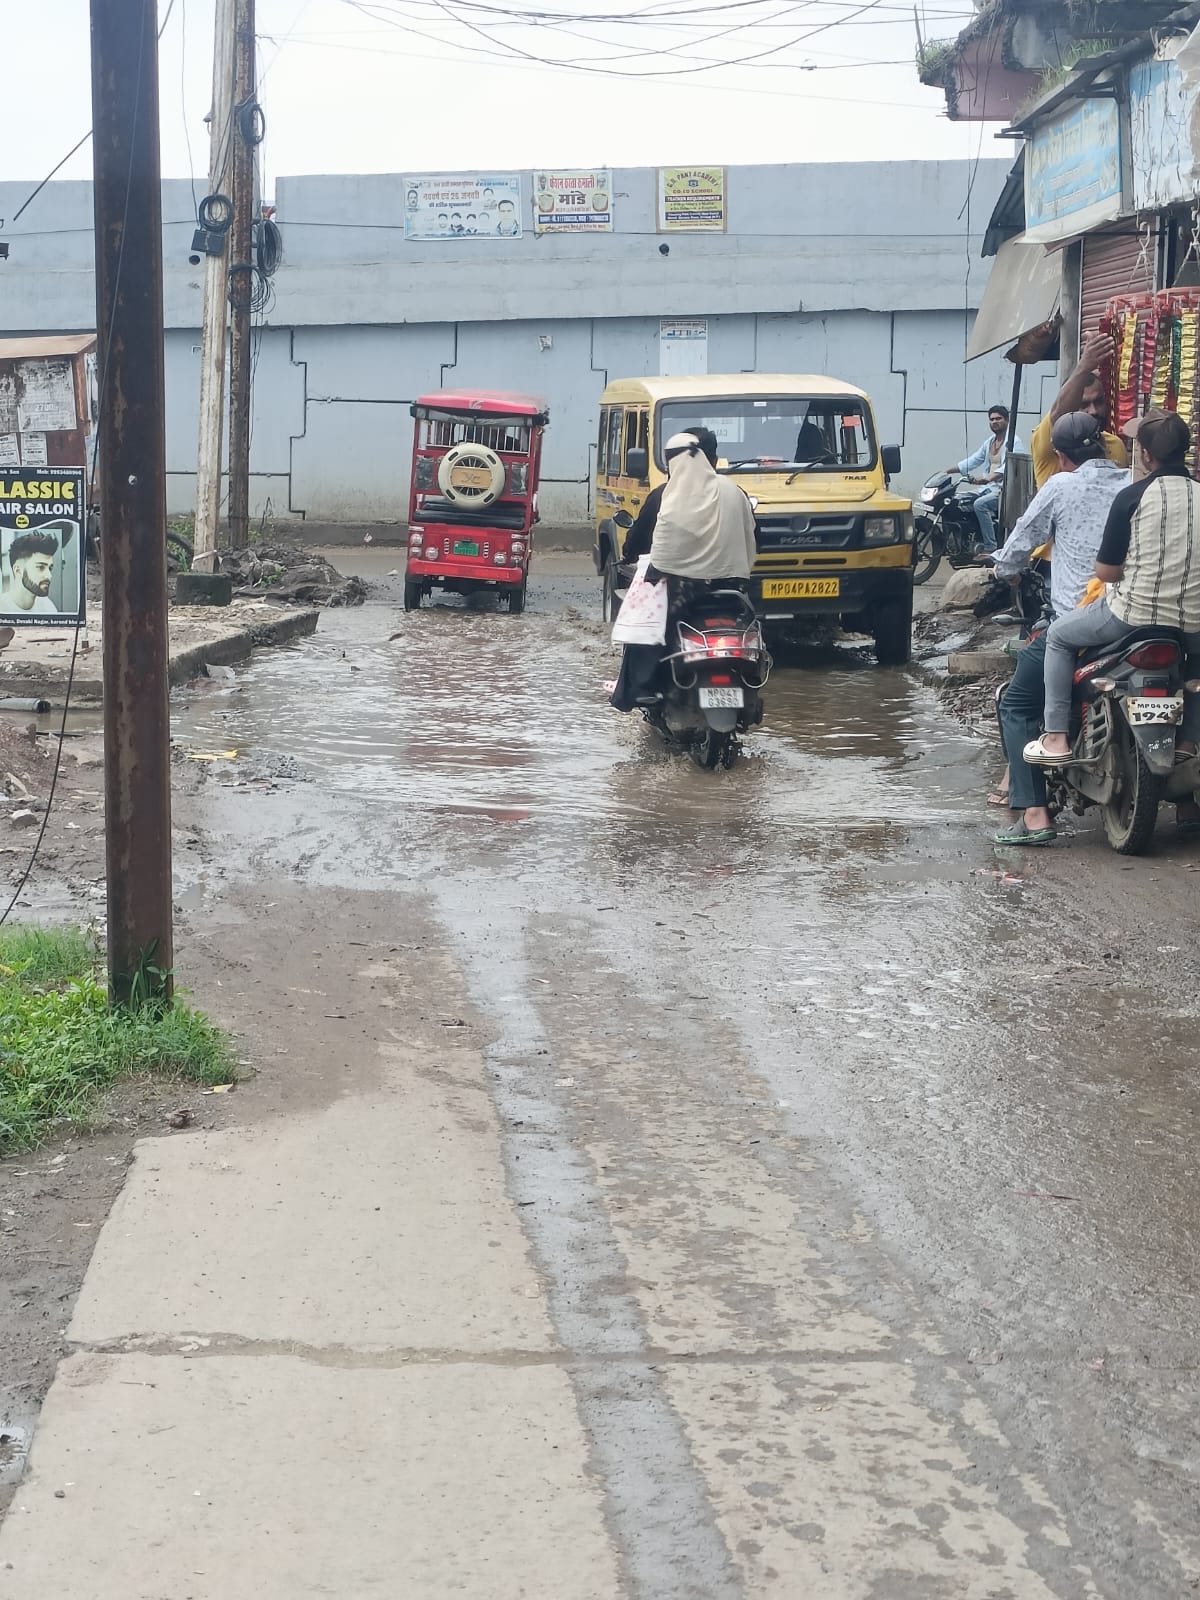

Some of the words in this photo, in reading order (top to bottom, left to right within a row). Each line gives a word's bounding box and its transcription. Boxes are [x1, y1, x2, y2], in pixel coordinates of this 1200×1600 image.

[0, 481, 75, 499] LASSIC
[0, 503, 22, 514] AIR
[24, 503, 74, 515] SALON
[770, 580, 838, 596] MP04PA2822
[1132, 711, 1180, 722] 194
